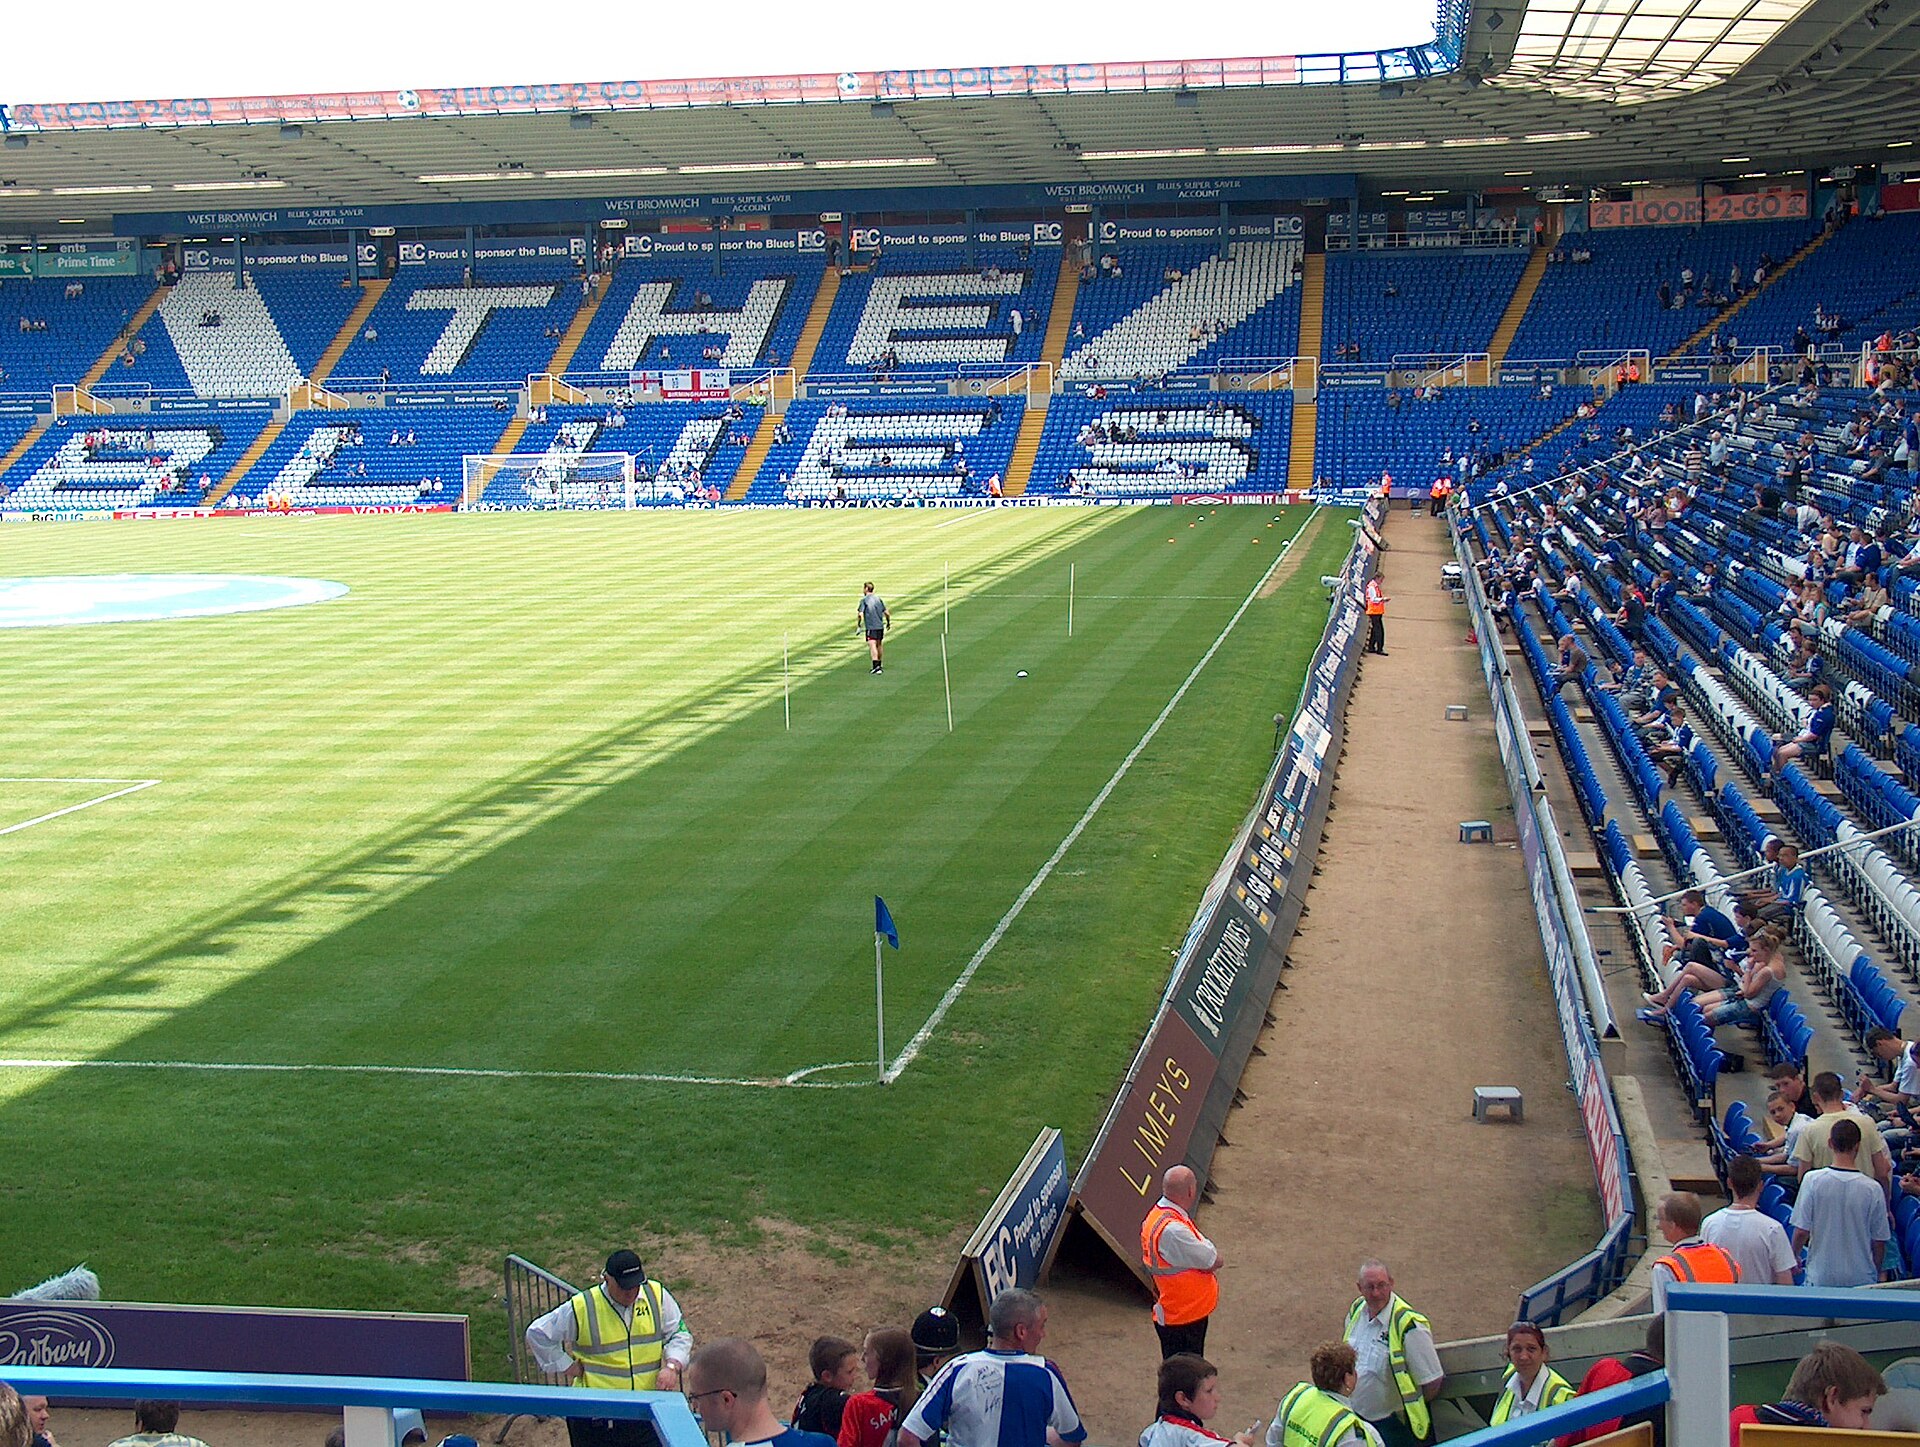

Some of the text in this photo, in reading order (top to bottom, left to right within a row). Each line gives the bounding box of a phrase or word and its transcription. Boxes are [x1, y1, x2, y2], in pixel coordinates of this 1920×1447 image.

[1044, 183, 1144, 196] WEST BROMWICH
[1156, 180, 1241, 190] BLUES SUPER SAVER
[1178, 189, 1220, 198] ACCOUNT
[605, 198, 699, 211] WEST BROMWICH
[711, 197, 735, 205] BLUES
[732, 204, 772, 212] ACCOUNT
[1620, 196, 1780, 225] FLOORS-2-GO
[187, 212, 278, 224] WEST BROMWICH
[307, 218, 345, 226] ACCOUNT
[883, 234, 915, 245] Proud
[918, 234, 929, 244] to
[979, 232, 997, 242] the
[1000, 231, 1031, 241] Blues
[1119, 228, 1152, 239] Proud
[1155, 228, 1167, 237] to
[1169, 227, 1215, 240] sponsor
[1239, 225, 1271, 235] Blues
[654, 238, 795, 253] Proud to spnsor the Blues
[428, 249, 459, 260] Proud
[474, 248, 516, 260] sponsor
[518, 246, 536, 257] the
[538, 245, 568, 256] Blues
[58, 256, 116, 268] Prime Time
[212, 252, 349, 266] Prou to sponsor the Blues
[880, 387, 901, 395] Expect
[218, 401, 239, 409] Expect
[455, 396, 475, 404] Expect
[1232, 494, 1262, 505] BRING
[1264, 493, 1273, 504] IT
[1119, 1057, 1191, 1197] LIMEYS
[1013, 1203, 1034, 1249] Proud
[1032, 1198, 1041, 1218] to
[1040, 1159, 1063, 1208] sponsor
[1029, 1203, 1058, 1258] the Blues
